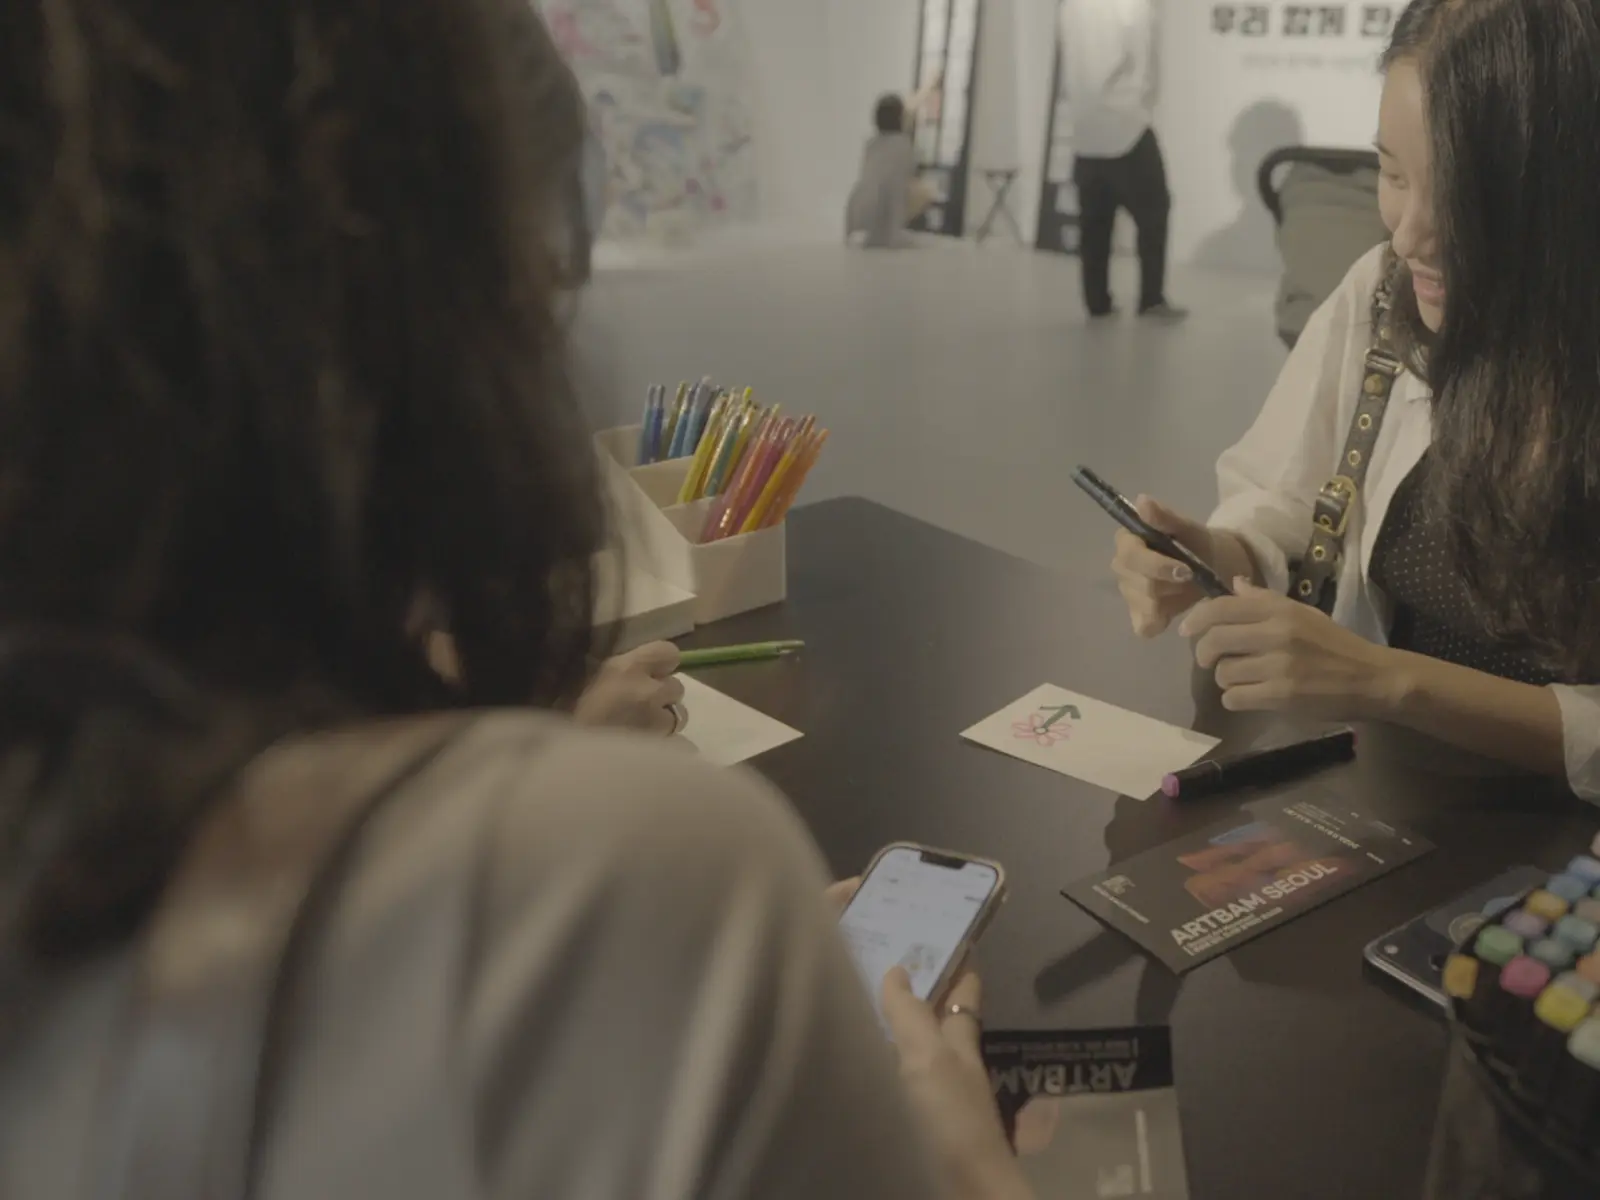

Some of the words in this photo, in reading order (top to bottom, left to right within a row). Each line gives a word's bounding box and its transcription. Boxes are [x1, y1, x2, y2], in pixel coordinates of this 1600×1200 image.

[1212, 5, 1269, 36] 우리
[1170, 892, 1268, 946] ARTBAM
[1261, 862, 1338, 900] SEOUL
[994, 1061, 1137, 1096] ARTBAM
